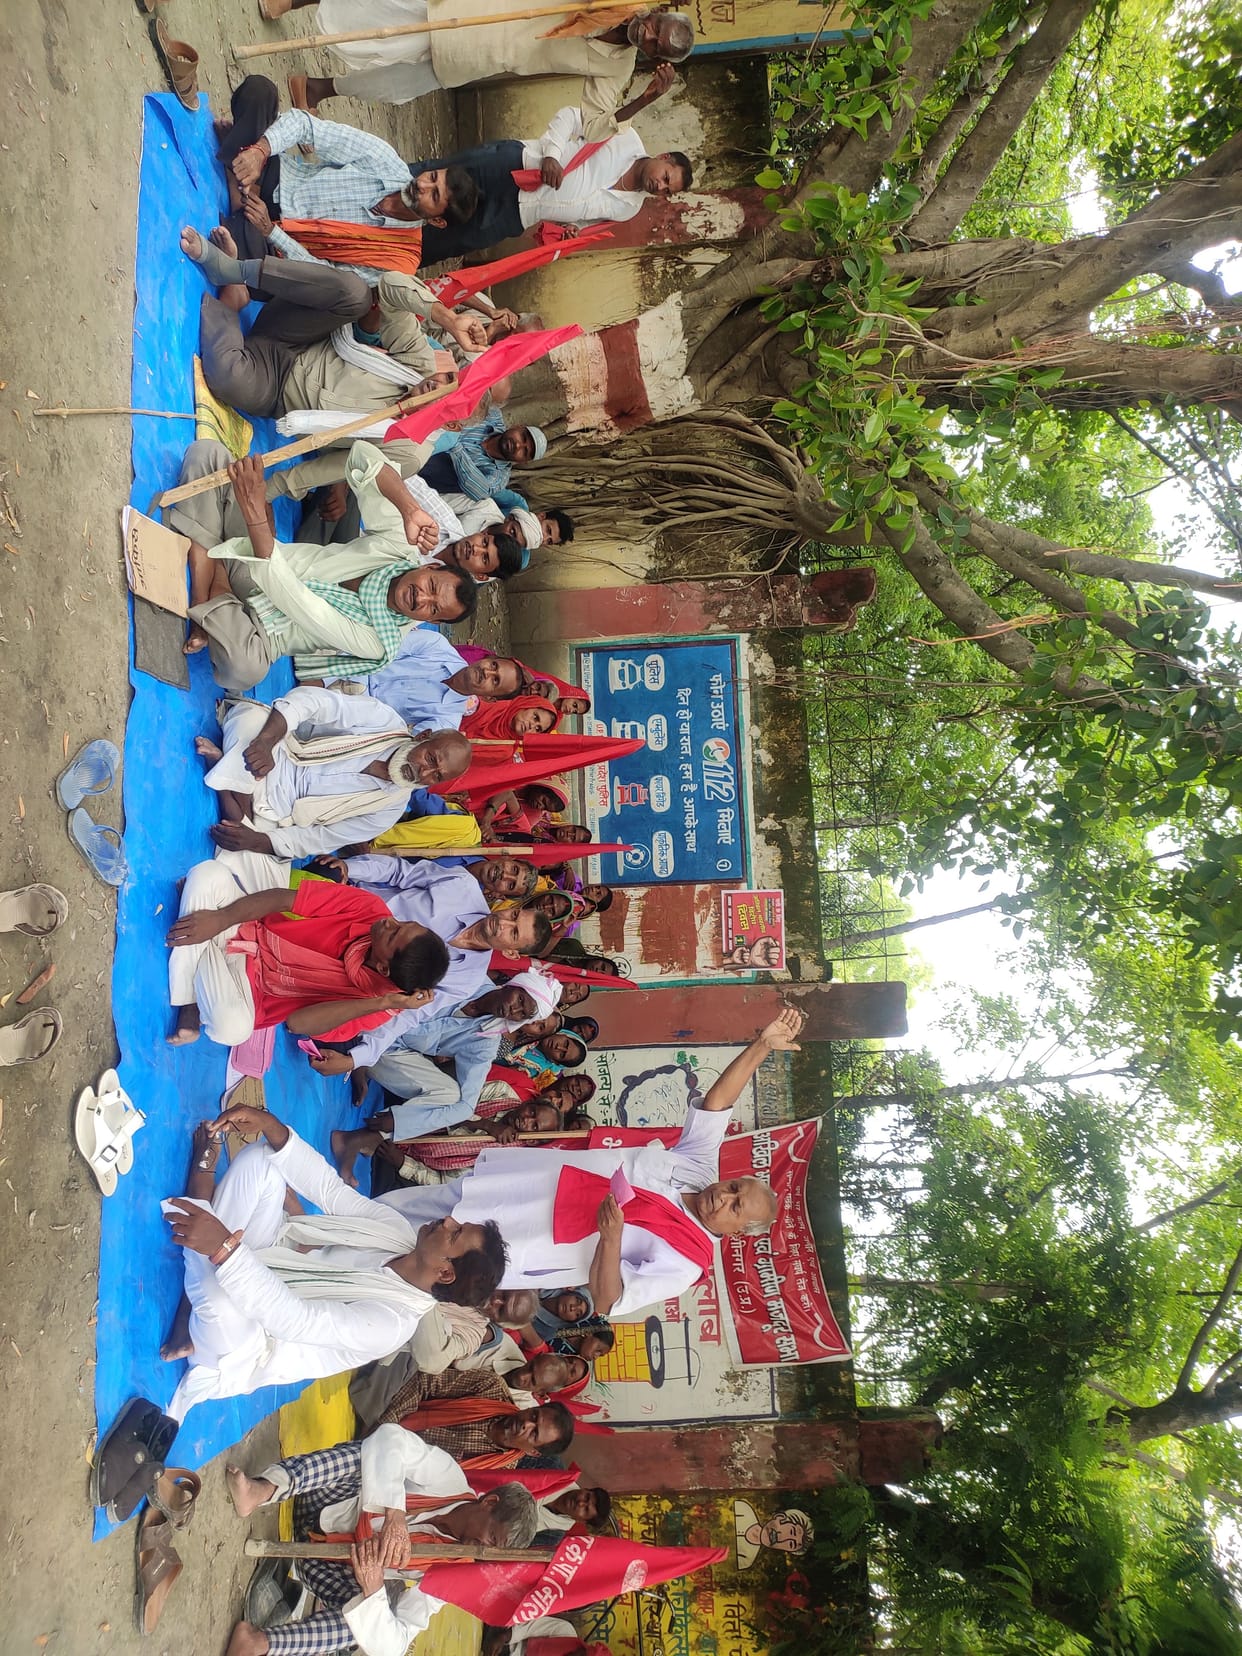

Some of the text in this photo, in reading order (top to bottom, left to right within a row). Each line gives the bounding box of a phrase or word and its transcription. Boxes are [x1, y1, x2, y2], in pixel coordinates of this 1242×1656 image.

[646, 660, 662, 685] पुलिस
[676, 688, 690, 705] दिन
[675, 709, 693, 720] हो
[679, 722, 691, 735] या
[702, 673, 735, 846] फोन उठाएं 112 मिलाएं
[679, 763, 693, 782] हम
[596, 784, 610, 807] पुलिस
[680, 784, 699, 793] है
[682, 797, 698, 829] आपके
[684, 829, 698, 853] साथ
[594, 1052, 617, 1092] सौजन्य
[751, 1132, 779, 1168] अखिल
[729, 1235, 746, 1274] शीनगर
[754, 1238, 780, 1256] एवं
[752, 1257, 786, 1297] ग्रामीण
[761, 1299, 794, 1335] मजदूर
[776, 1335, 801, 1363] सभा
